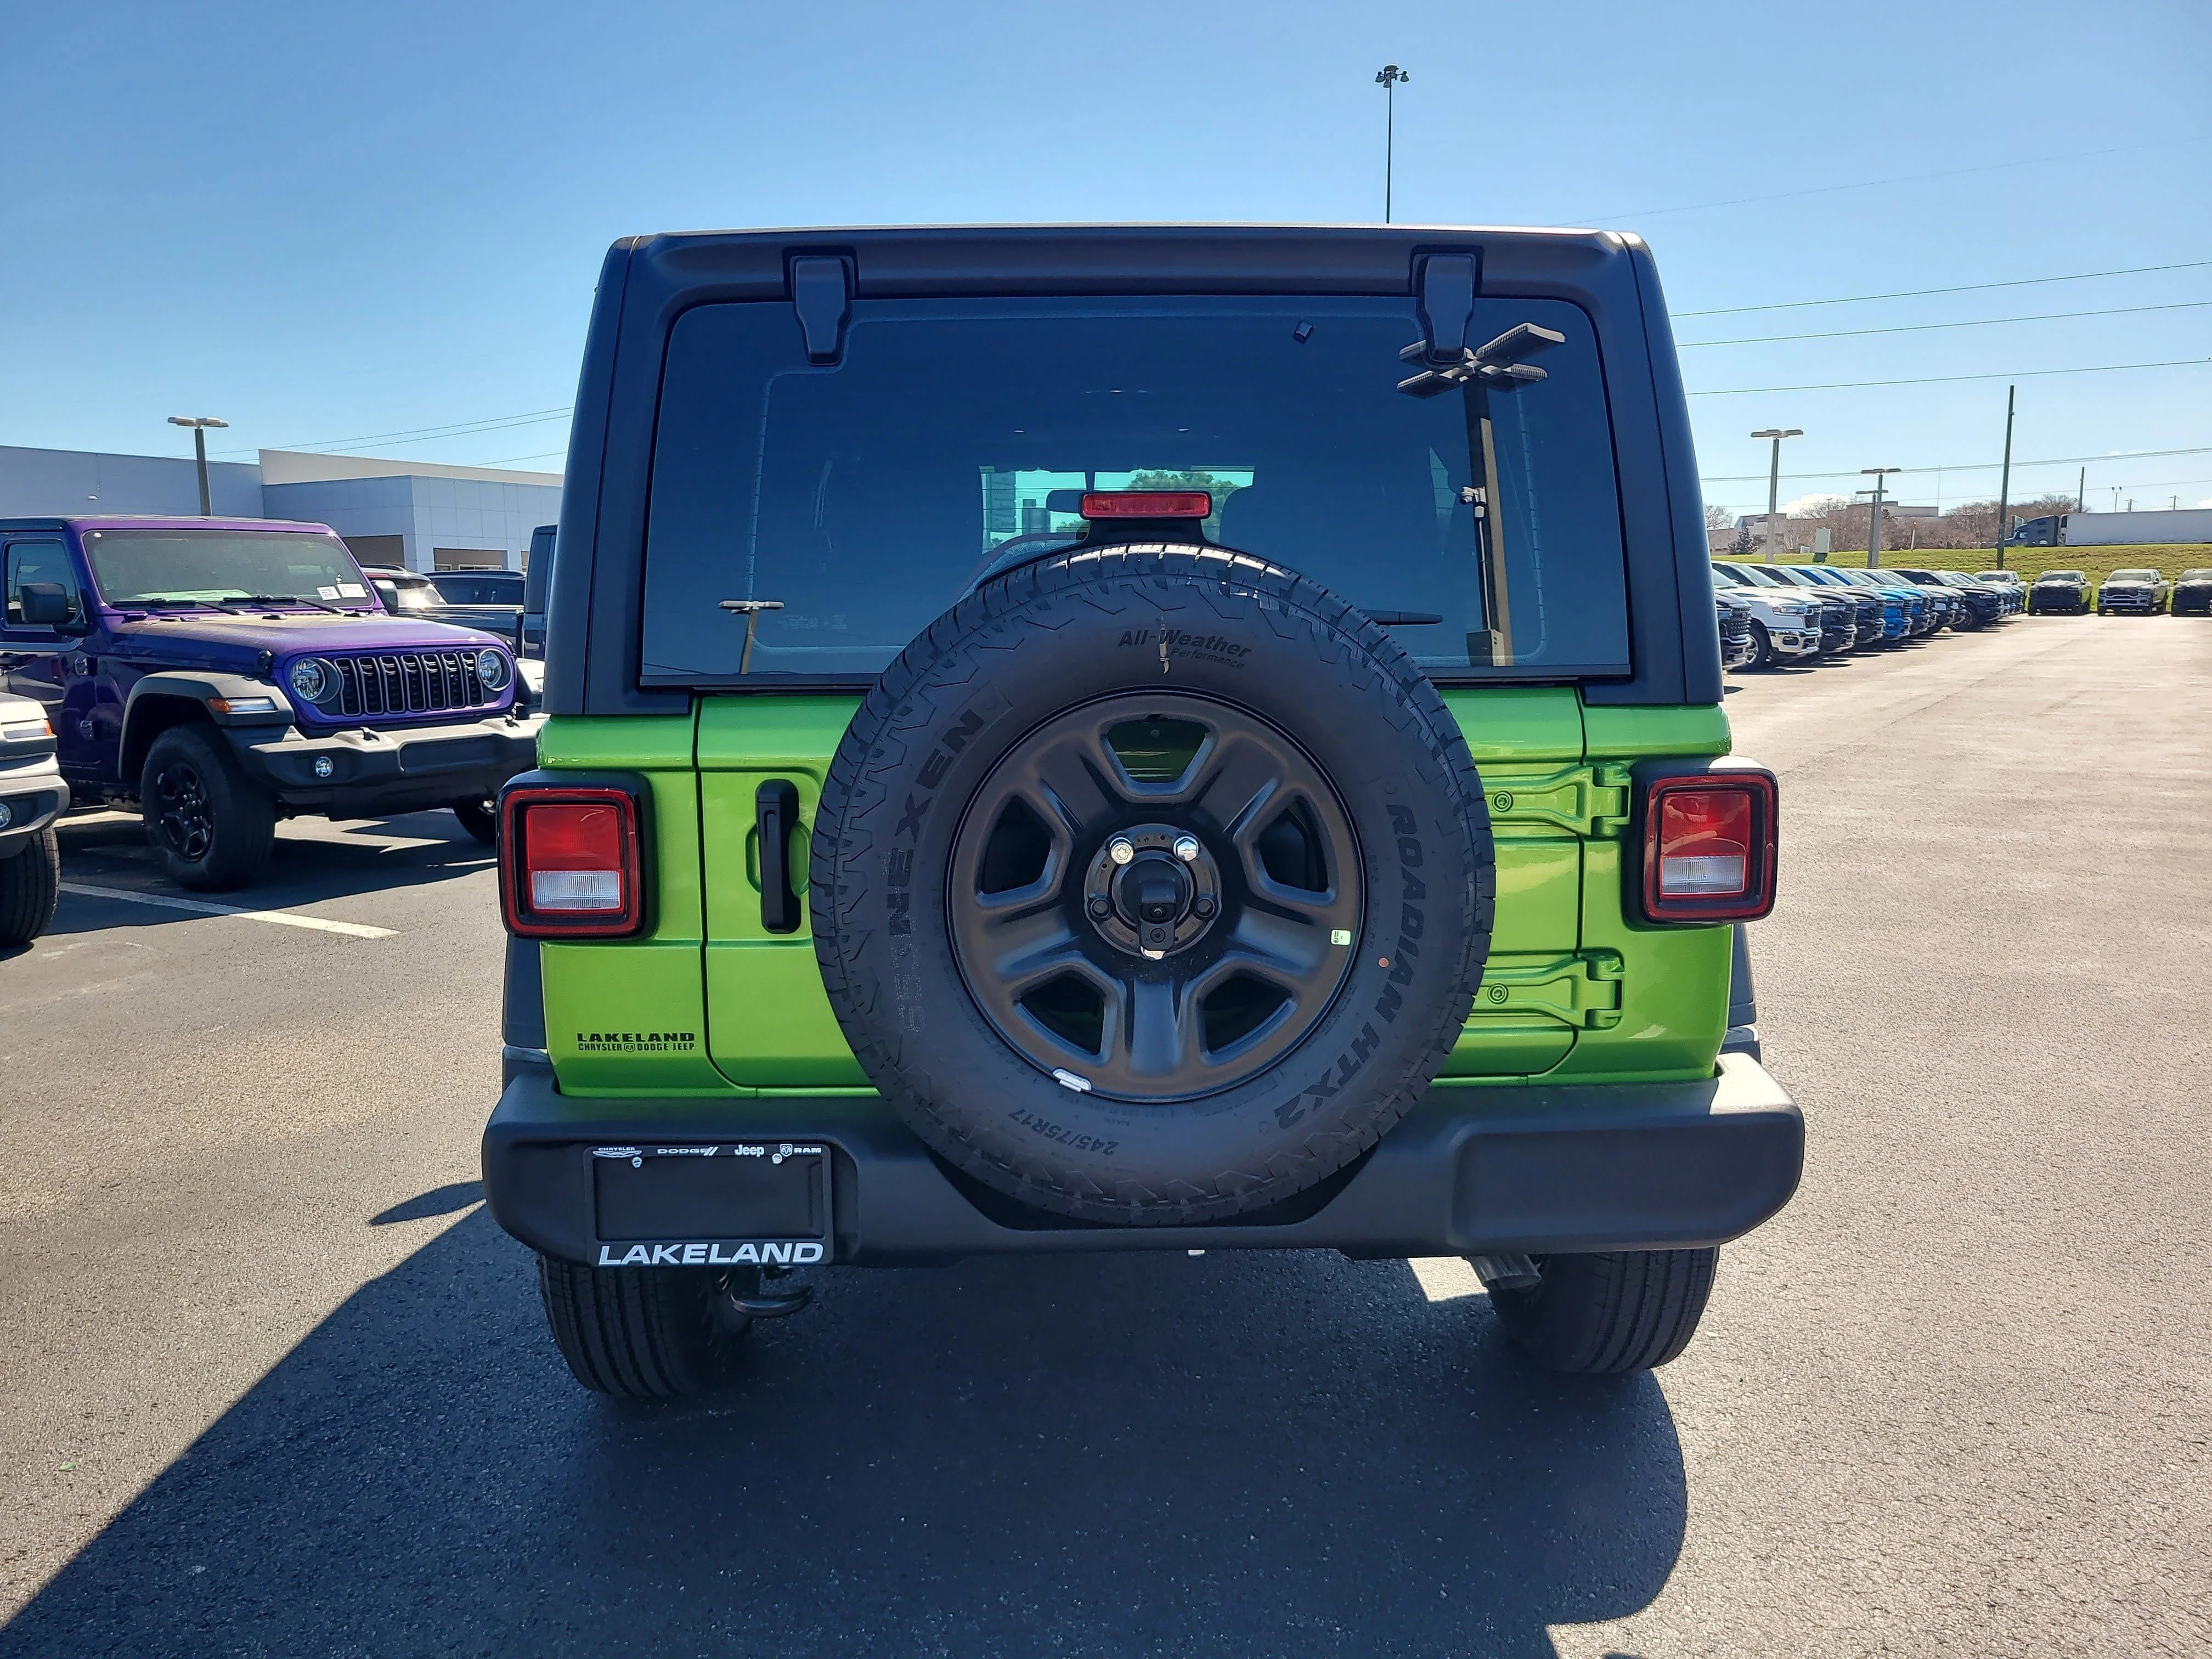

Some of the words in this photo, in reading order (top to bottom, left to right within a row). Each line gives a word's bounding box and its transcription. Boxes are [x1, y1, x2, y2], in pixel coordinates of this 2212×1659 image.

[887, 708, 985, 935] NEXEN
[1375, 804, 1425, 1023] ROADIAN
[577, 1032, 695, 1042] LAKELAND
[578, 1043, 622, 1051] CHRYSLER
[1273, 1022, 1380, 1129] HTX2
[1008, 1109, 1120, 1155] 245/75R17
[734, 1144, 765, 1158] Jeep
[599, 1243, 823, 1266] LAKELAND
